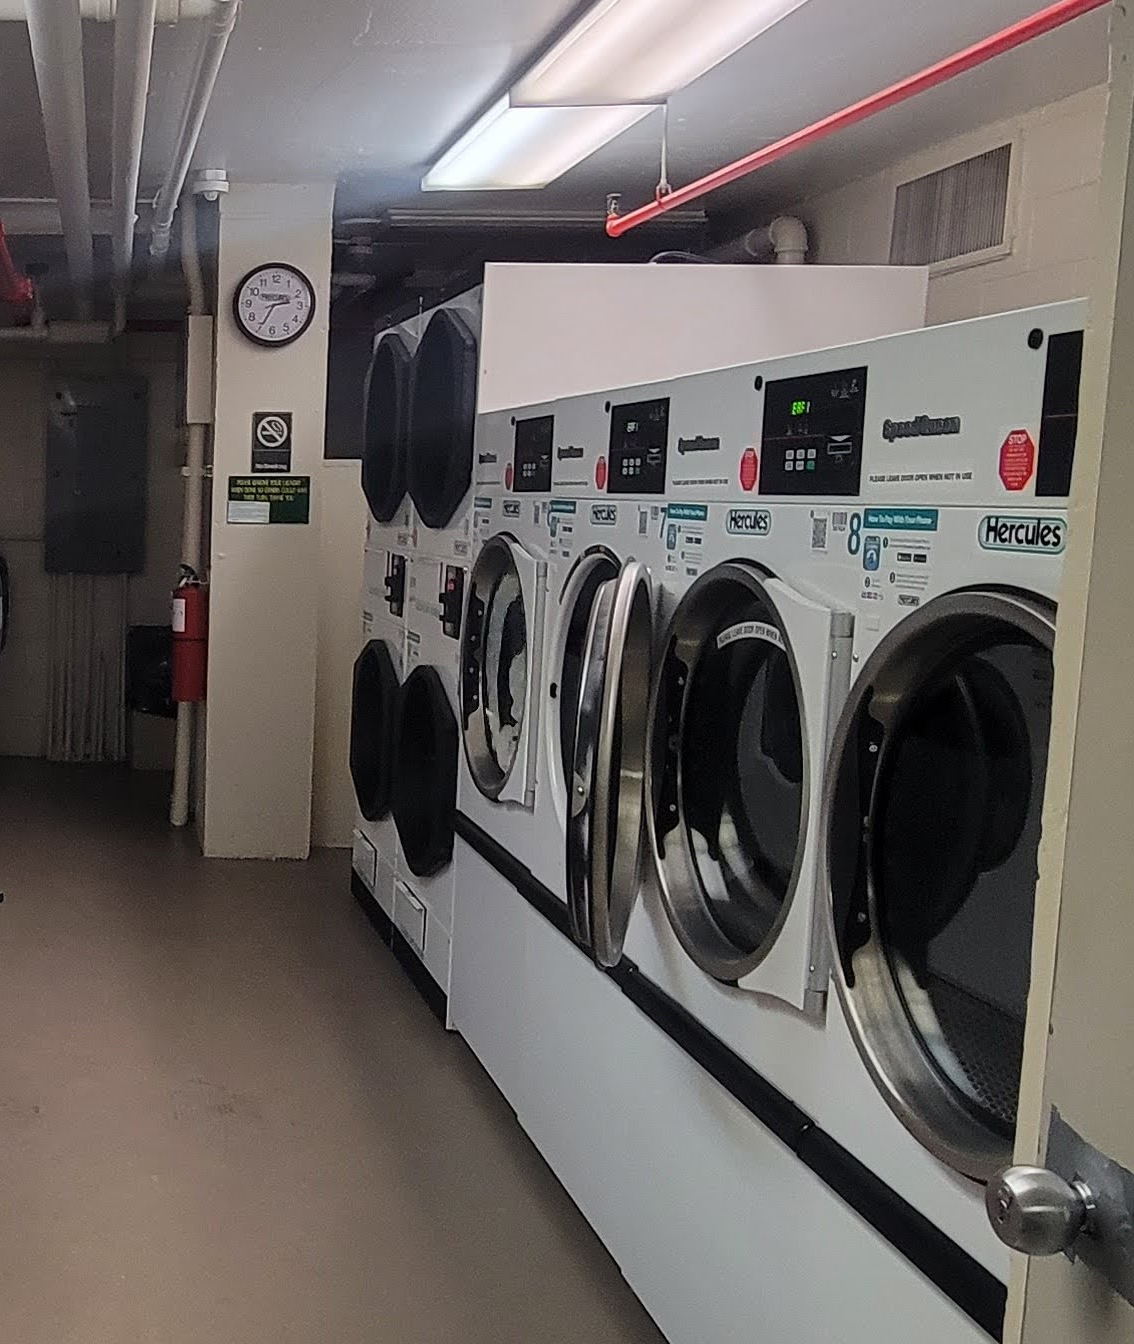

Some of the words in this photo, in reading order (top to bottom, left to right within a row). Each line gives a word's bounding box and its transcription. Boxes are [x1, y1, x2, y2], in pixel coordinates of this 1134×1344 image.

[260, 279, 267, 287] 11
[272, 275, 281, 284] 12
[250, 287, 259, 296] 10
[295, 289, 302, 298] 2
[245, 299, 252, 308] 9
[297, 301, 303, 310] 3
[248, 312, 255, 321] 8
[292, 315, 298, 323] 4
[269, 326, 275, 334] 6
[283, 323, 289, 332] 5
[1008, 434, 1027, 444] STOP
[730, 511, 768, 531] Hercules
[848, 512, 862, 555] 8
[986, 517, 1061, 547] Hercules
